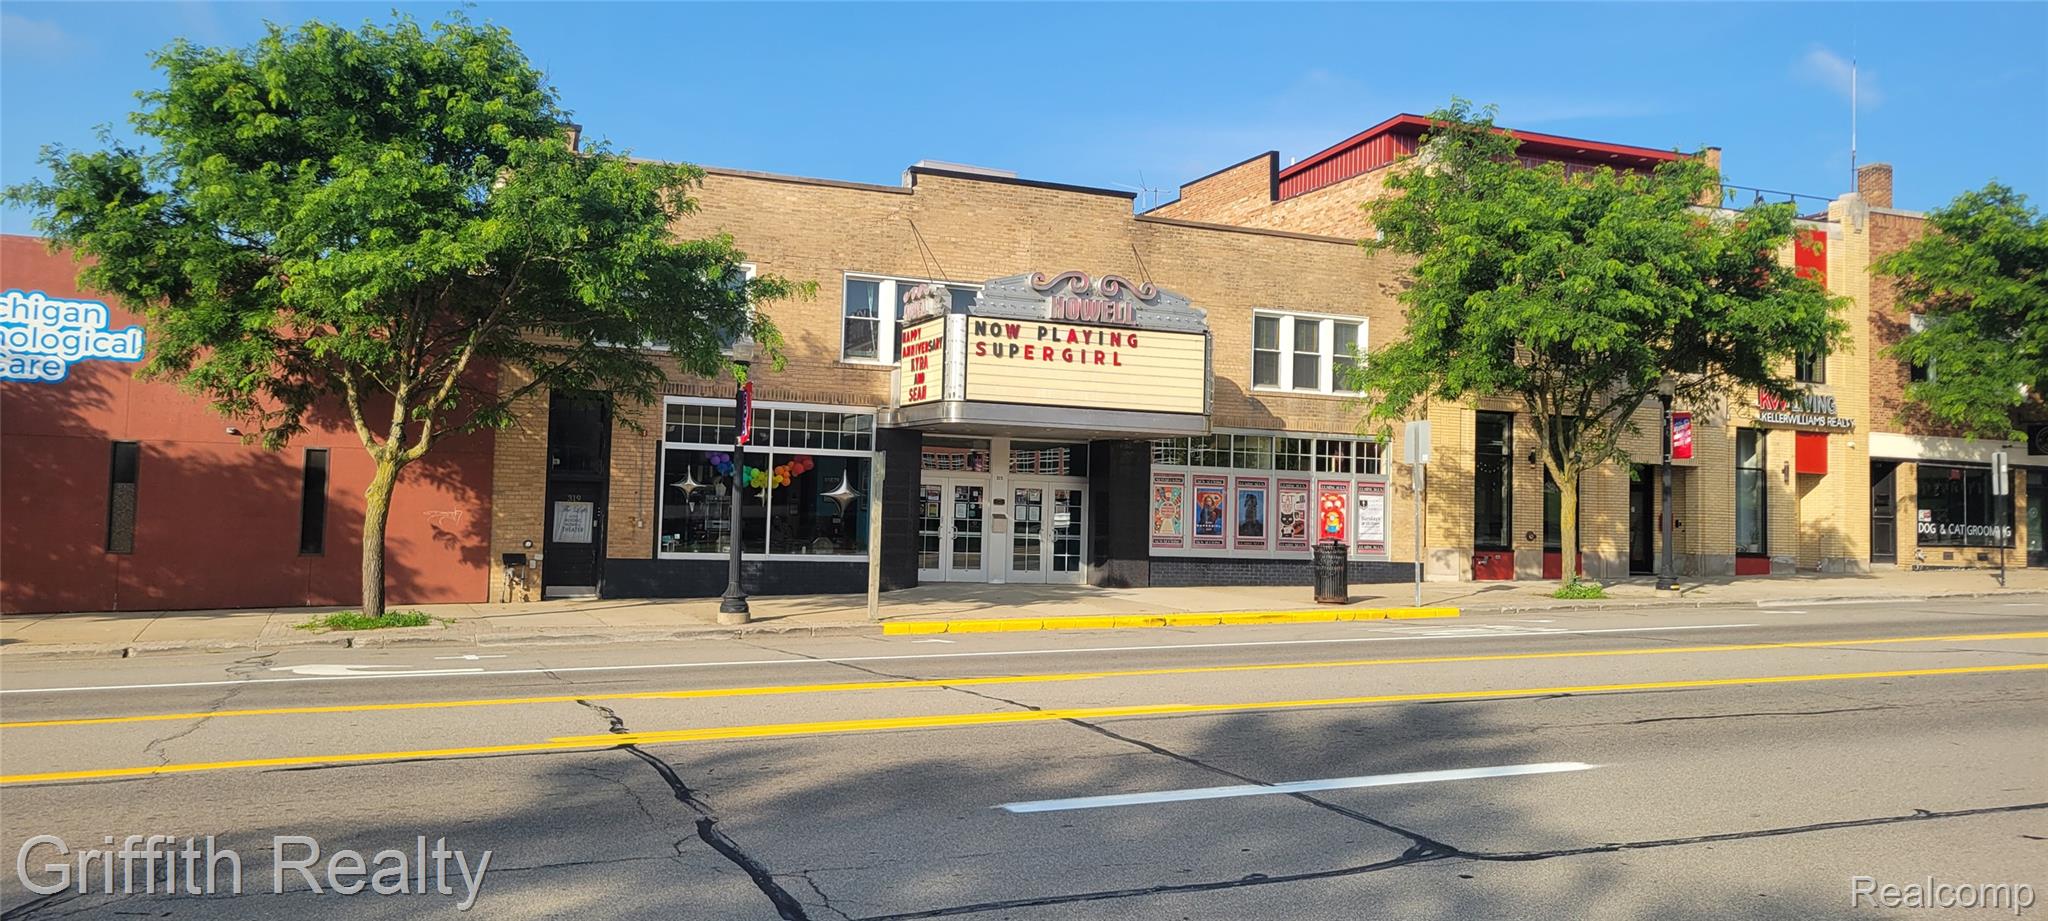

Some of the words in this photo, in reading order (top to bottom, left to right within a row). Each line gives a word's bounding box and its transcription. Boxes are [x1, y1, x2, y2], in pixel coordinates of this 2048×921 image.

[1050, 295, 1136, 325] HOWELL
[902, 327, 922, 343] HAPPY
[975, 320, 1021, 340] NOW
[1037, 325, 1139, 349] PLAYING
[902, 336, 943, 358] ANNIVERSARY
[975, 341, 1122, 367] SUPERGIRL
[911, 355, 928, 372] KYRA
[914, 372, 925, 385] AND
[908, 385, 927, 402] SEAN
[1827, 416, 1856, 429] REALTY
[1918, 522, 1936, 534] DOG
[1940, 523, 1946, 535] &
[1948, 523, 1965, 535] CAT
[1967, 525, 2012, 537] GROOMNG
